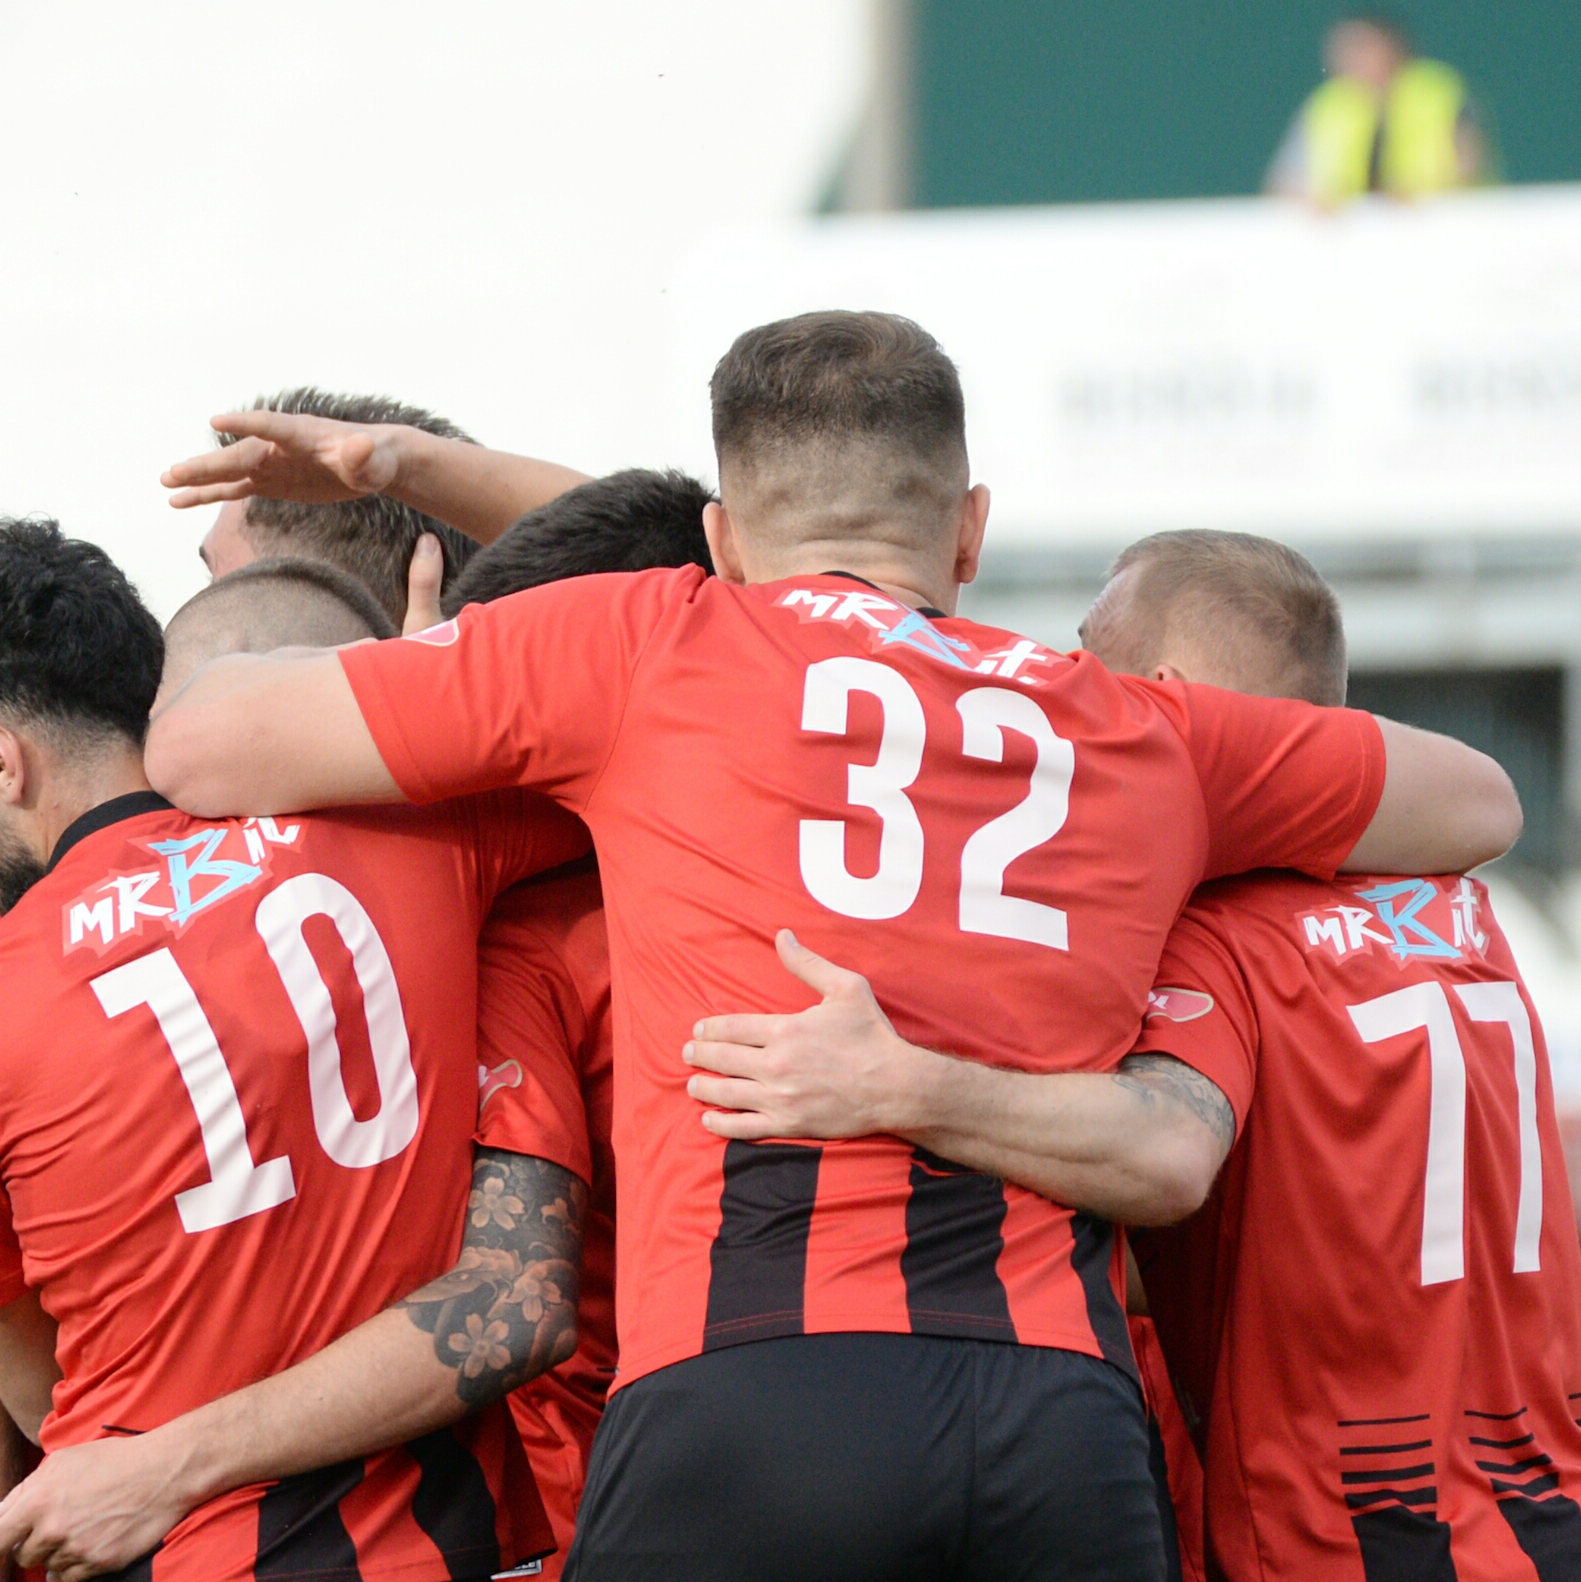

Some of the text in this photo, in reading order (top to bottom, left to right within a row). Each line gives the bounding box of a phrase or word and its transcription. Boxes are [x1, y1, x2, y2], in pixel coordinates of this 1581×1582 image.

[799, 656, 1075, 952] 32
[89, 872, 420, 1234] 10
[1346, 980, 1543, 1286] 77
